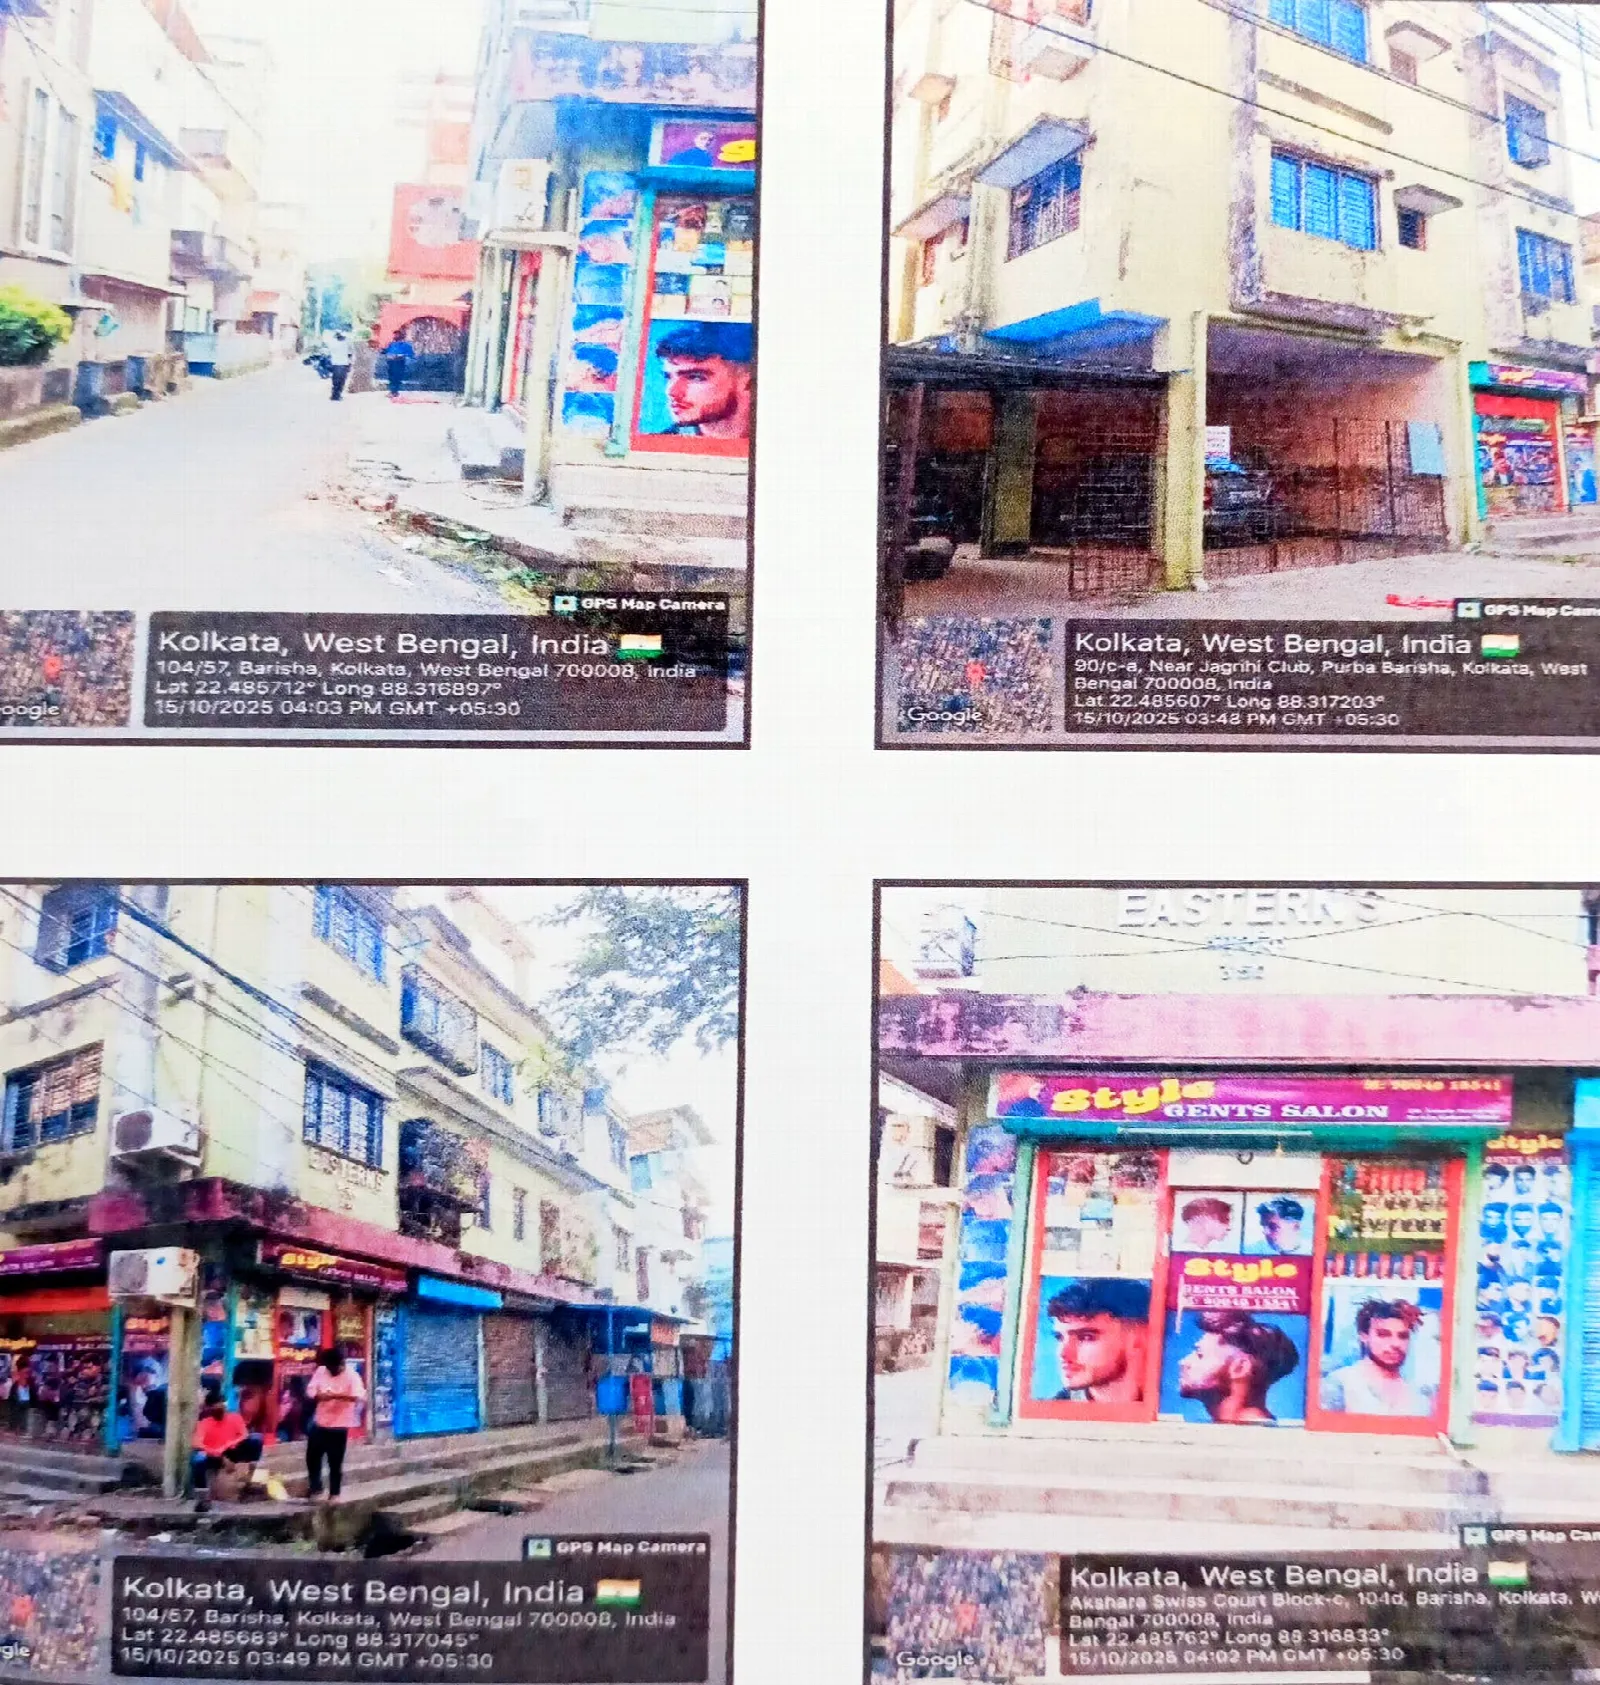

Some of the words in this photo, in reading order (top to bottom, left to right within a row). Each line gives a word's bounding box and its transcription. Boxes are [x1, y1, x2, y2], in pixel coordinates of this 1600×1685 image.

[1050, 1078, 1217, 1115] Style
[1162, 1103, 1272, 1118] GENTS
[1280, 1104, 1389, 1118] SALON
[1183, 1257, 1298, 1284] Style
